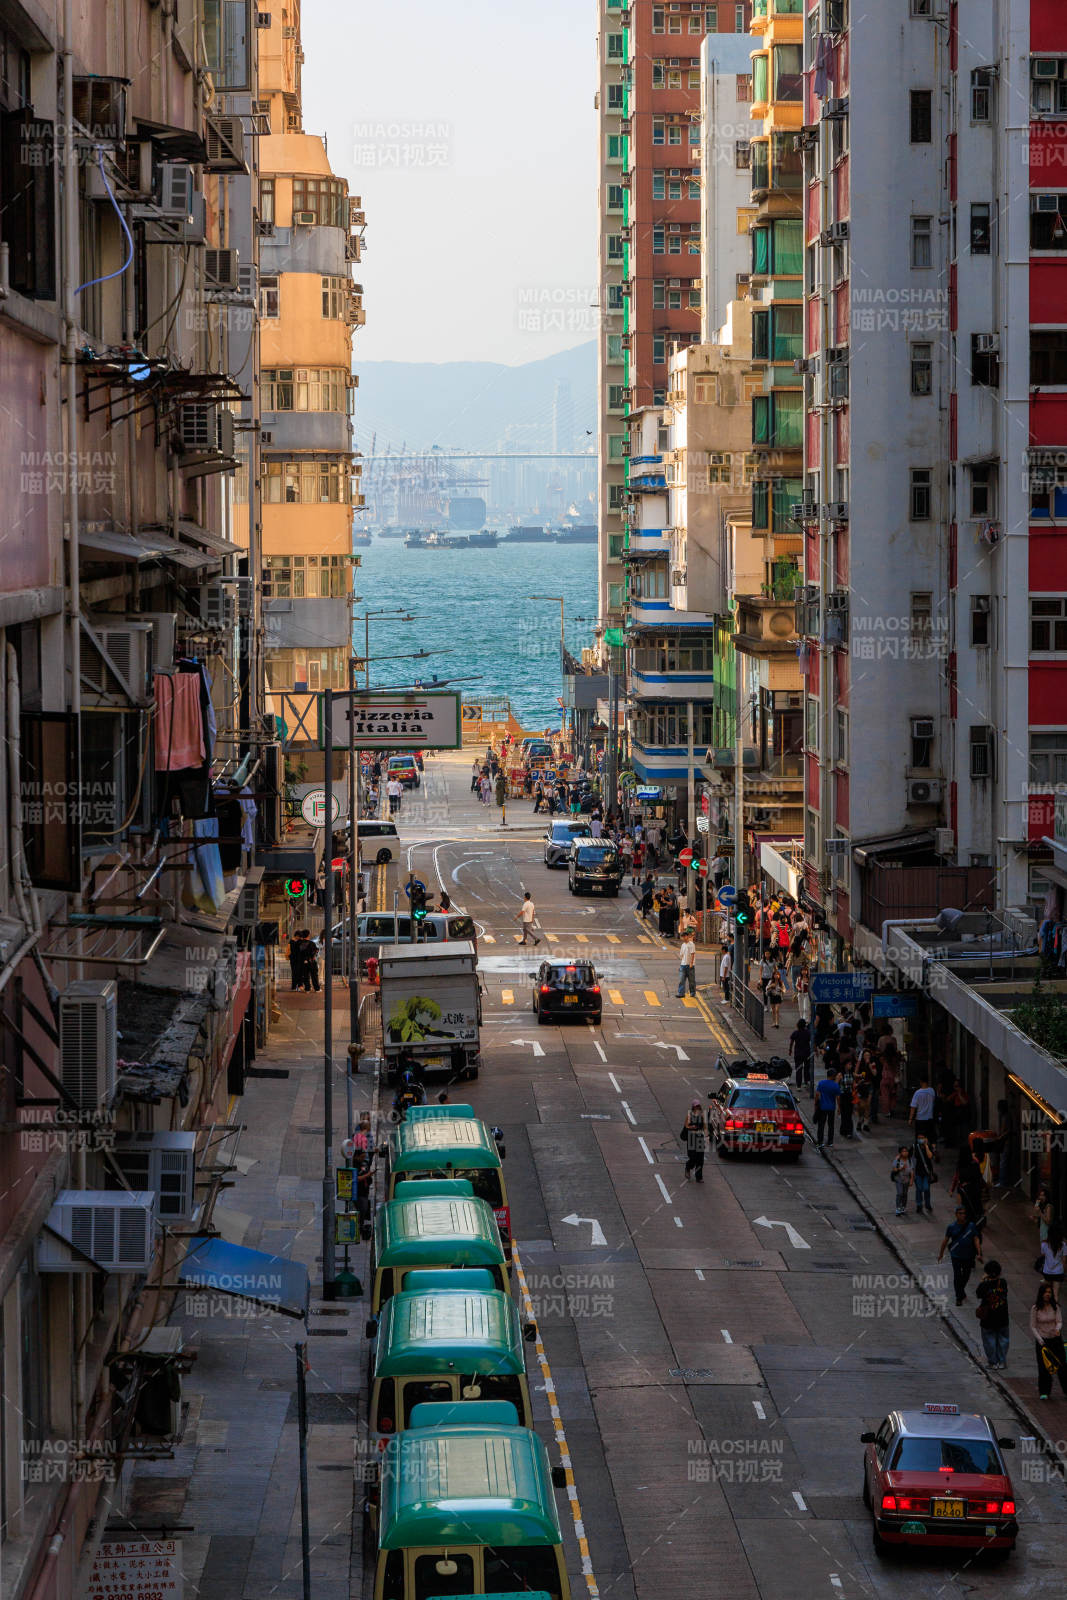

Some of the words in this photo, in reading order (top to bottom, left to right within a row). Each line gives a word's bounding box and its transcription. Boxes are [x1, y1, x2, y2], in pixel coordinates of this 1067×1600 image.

[345, 709, 434, 721] Pizzeria
[356, 722, 423, 733] Italia
[819, 976, 851, 984] Victoria
[442, 1012, 464, 1025] 式波
[96, 1541, 176, 1557] 裝飾工程公司
